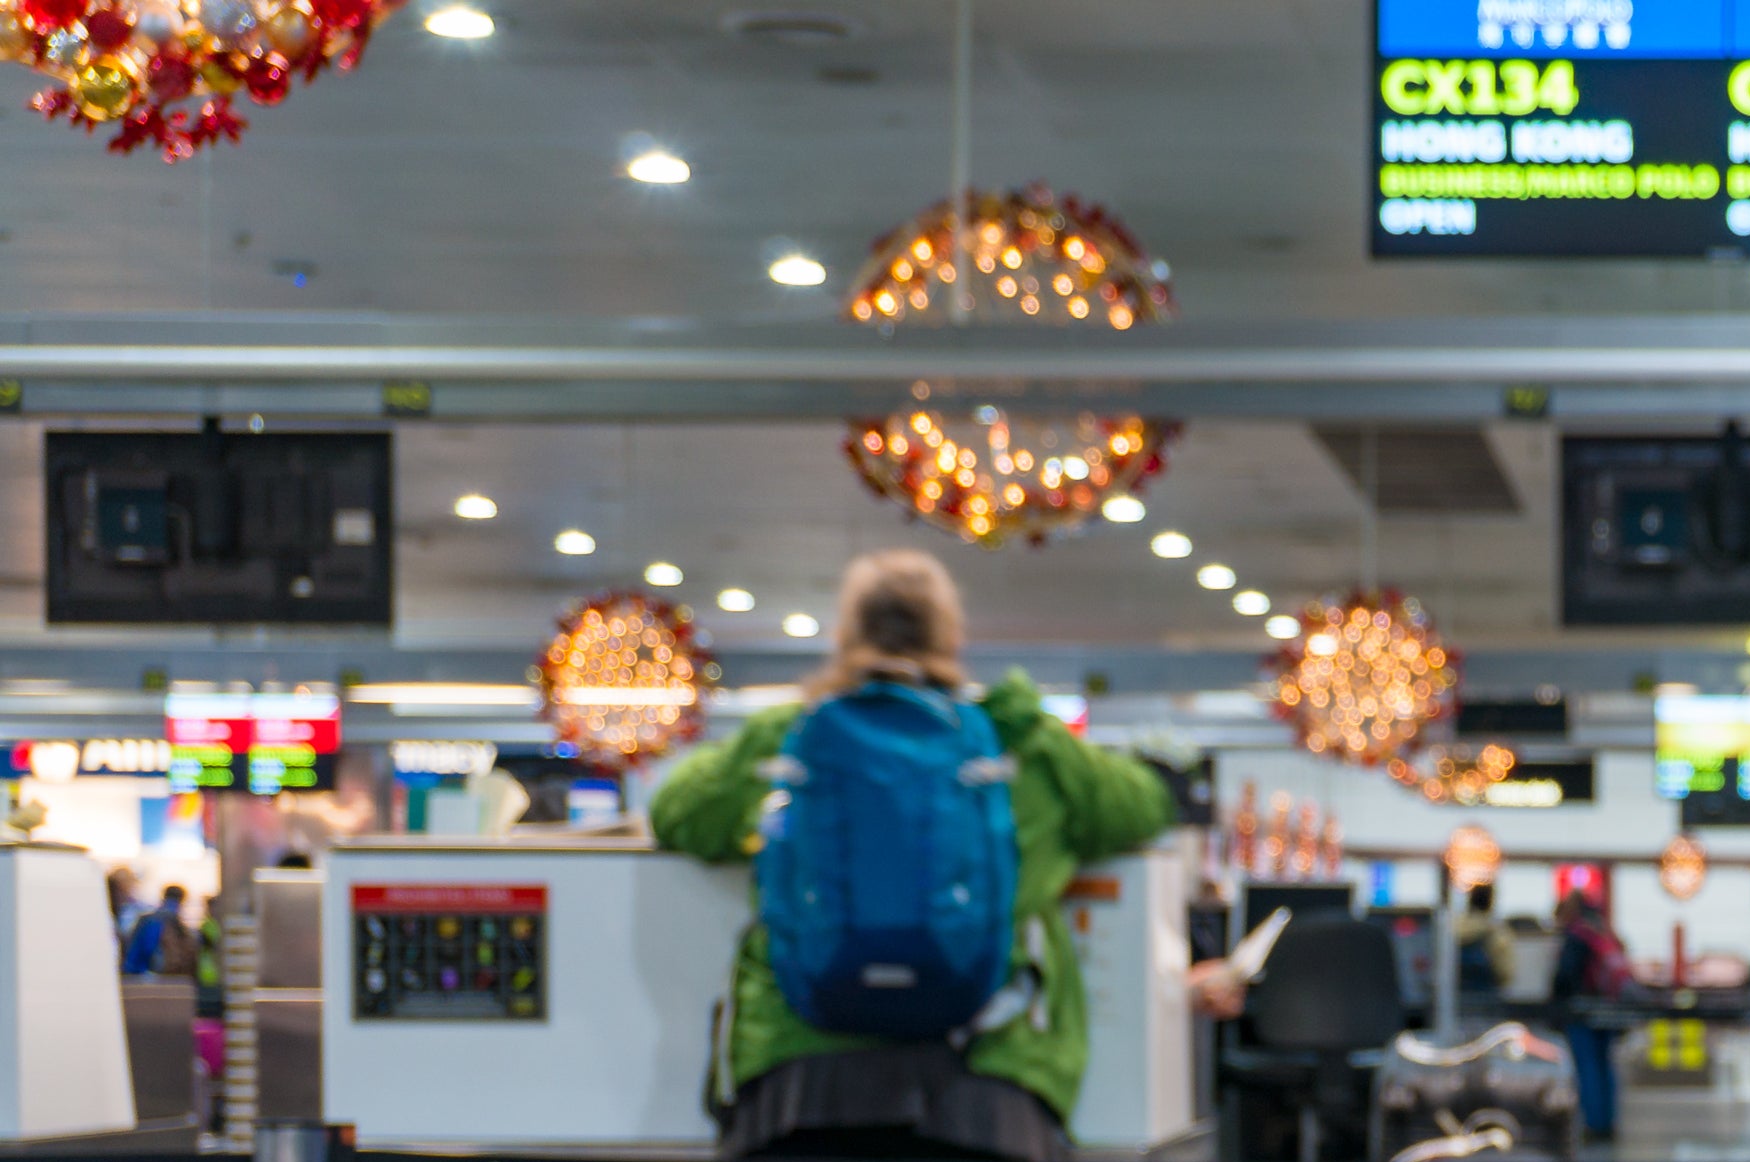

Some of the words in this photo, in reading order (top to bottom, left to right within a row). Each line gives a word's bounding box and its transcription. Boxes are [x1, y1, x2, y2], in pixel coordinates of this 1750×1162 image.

[1381, 59, 1579, 115] CX134
[1382, 119, 1507, 163] HONG
[1511, 119, 1634, 163] KONG
[1380, 198, 1476, 235] OPEN
